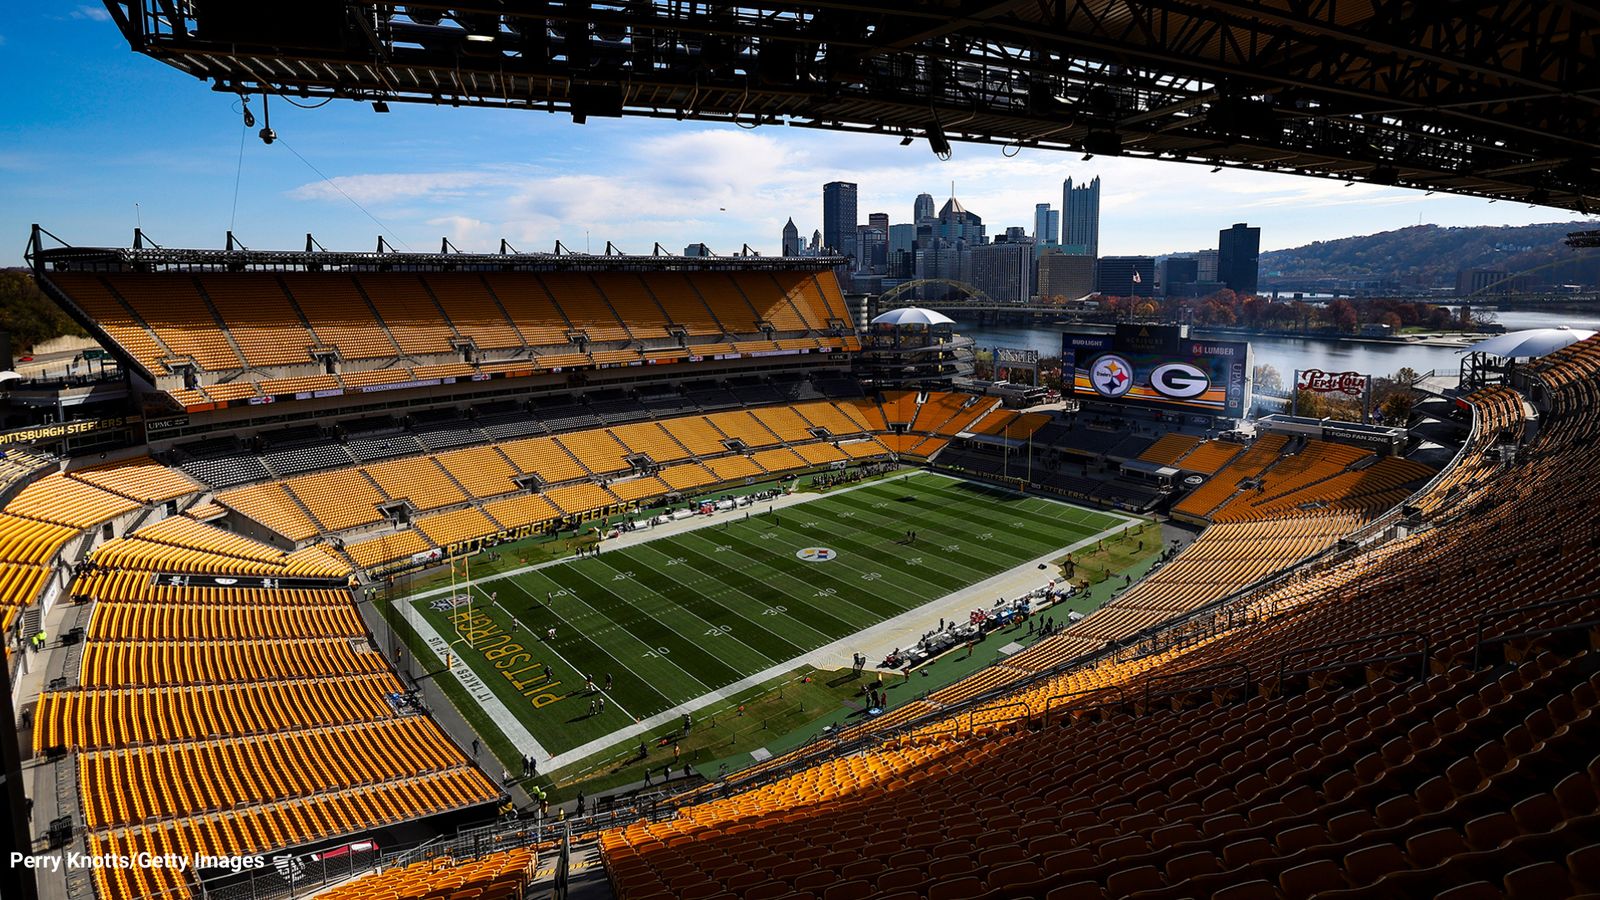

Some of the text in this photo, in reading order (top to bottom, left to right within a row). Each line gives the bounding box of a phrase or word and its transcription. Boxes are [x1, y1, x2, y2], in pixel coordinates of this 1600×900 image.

[1204, 346, 1234, 356] LUMBER
[1231, 363, 1242, 398] UPMC
[0, 417, 123, 445] PITTSBURGH STEELERS
[148, 421, 173, 430] UPMC
[1368, 435, 1388, 443] ZONE
[861, 572, 882, 581] 50
[818, 587, 838, 598] 40
[767, 605, 788, 616] 30
[709, 624, 733, 637] 20
[428, 636, 443, 647] US
[646, 646, 671, 659] 10
[447, 608, 567, 710] PITTSBURGH
[456, 668, 485, 693] TAKES
[476, 691, 494, 703] IT
